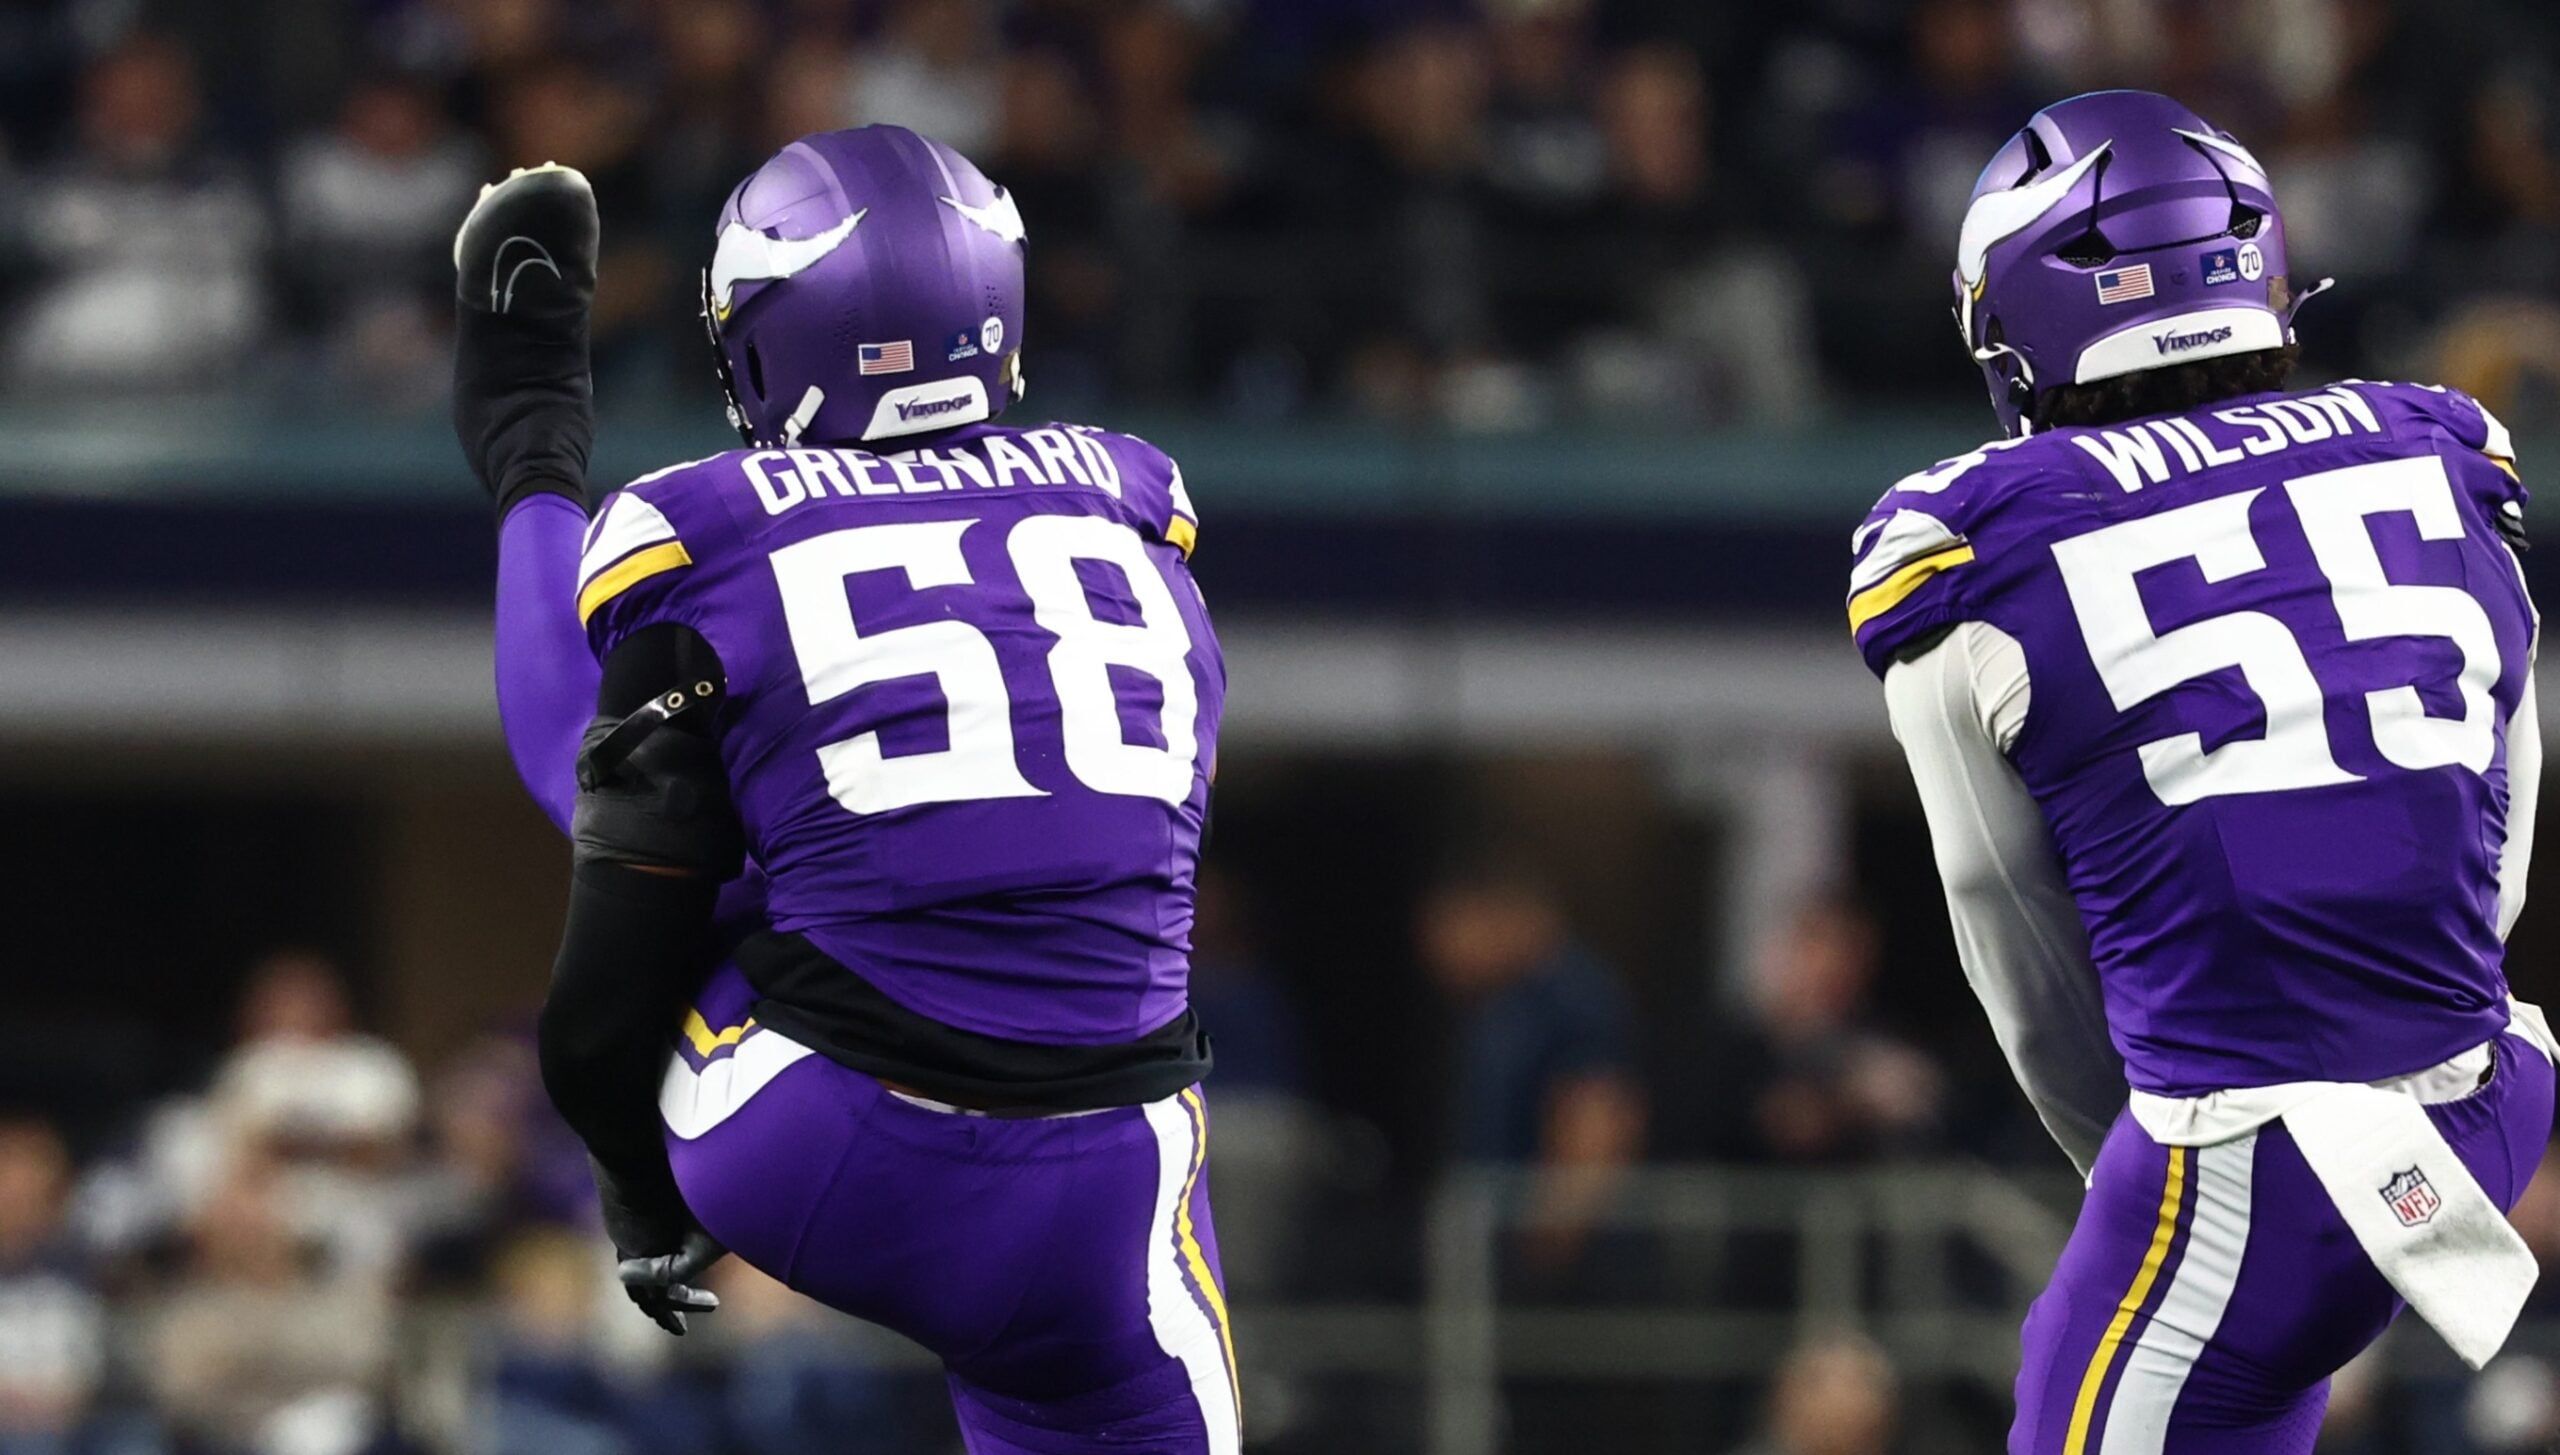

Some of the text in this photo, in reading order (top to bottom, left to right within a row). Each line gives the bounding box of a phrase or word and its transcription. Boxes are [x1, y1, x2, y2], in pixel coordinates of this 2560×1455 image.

[2241, 251, 2260, 273] 70
[986, 324, 999, 347] 70
[741, 428, 1122, 516] GREENARD
[2072, 387, 2381, 494] WILSON
[768, 514, 1200, 816] 58
[2050, 455, 2501, 807] 55
[2396, 1187, 2437, 1222] NFL
